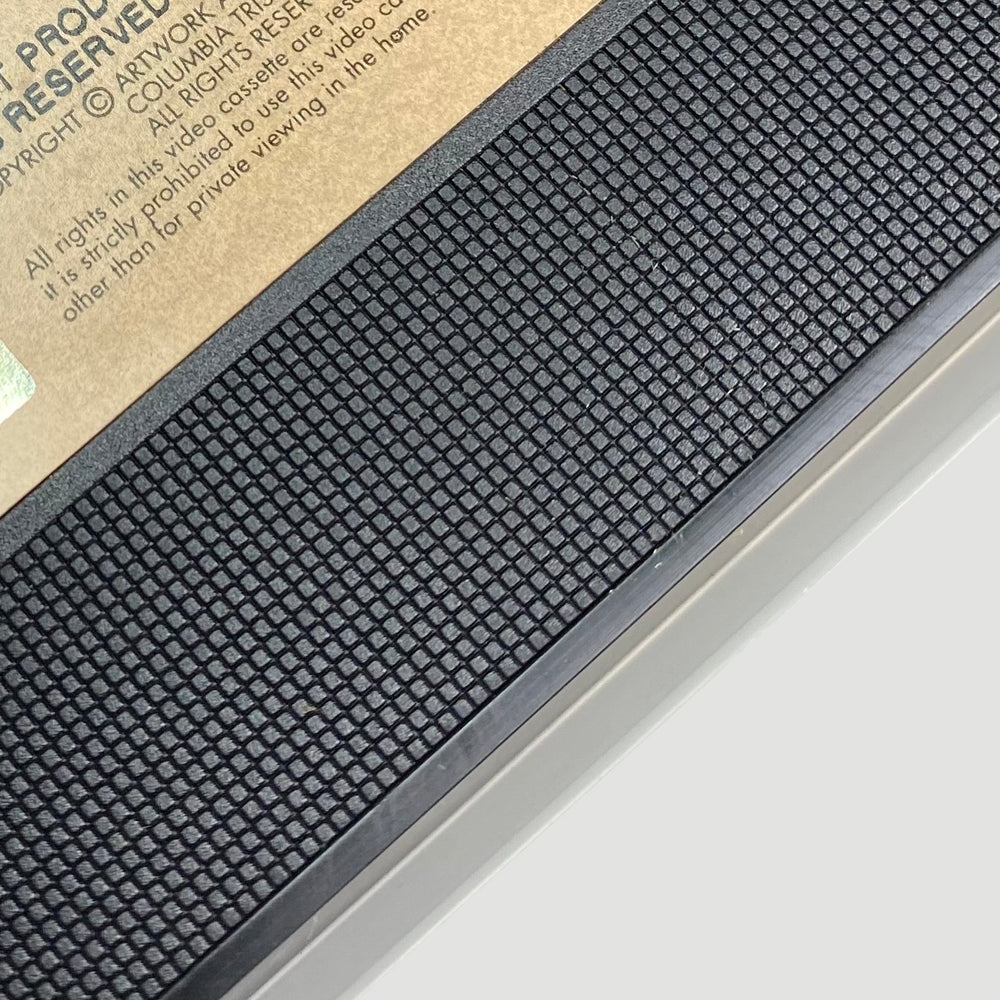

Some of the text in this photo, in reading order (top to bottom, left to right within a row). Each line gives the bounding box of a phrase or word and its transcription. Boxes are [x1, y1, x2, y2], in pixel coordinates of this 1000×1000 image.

[115, 2, 217, 93] ARTWORK
[127, 24, 235, 114] COLUMBIA
[147, 102, 184, 138] ALL
[178, 41, 252, 108] RIGHTS
[24, 244, 54, 280] All
[55, 204, 107, 254] rights
[105, 187, 129, 208] in
[128, 156, 164, 192] this
[164, 114, 216, 158] video
[218, 52, 289, 114] cassette
[291, 25, 324, 53] are
[40, 281, 60, 301] it
[57, 268, 79, 288] is
[80, 216, 139, 271] strictly
[140, 129, 234, 224] prohibited
[232, 117, 255, 139] to
[257, 88, 290, 119] use
[288, 58, 324, 93] this
[324, 15, 376, 60] video
[63, 276, 110, 323] other
[109, 239, 156, 280] than
[151, 214, 184, 241] for
[187, 159, 250, 222] private
[251, 98, 327, 160] viewing
[325, 76, 347, 98] in
[345, 54, 378, 80] the
